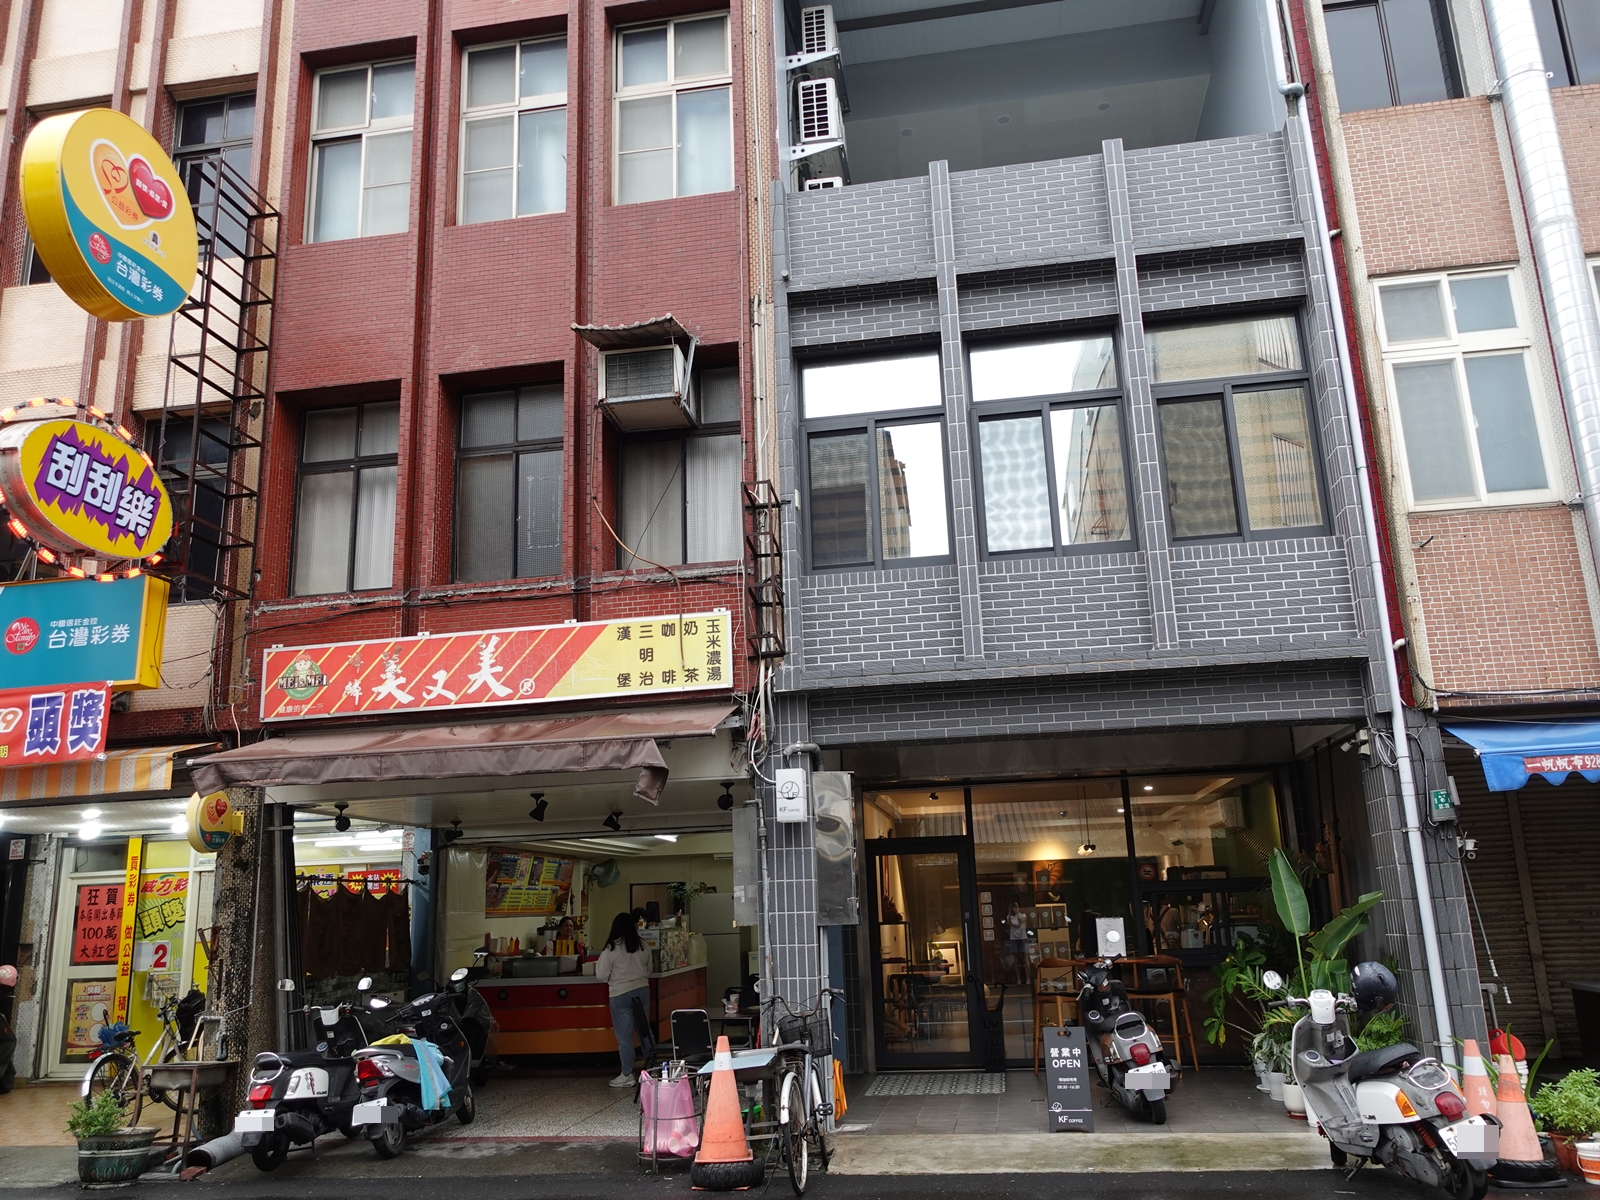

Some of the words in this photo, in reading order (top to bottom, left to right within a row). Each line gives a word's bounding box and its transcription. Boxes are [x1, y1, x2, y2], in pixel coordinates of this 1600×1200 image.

[112, 196, 139, 221] 公益彩券
[116, 260, 163, 302] 台灣彩券
[46, 440, 157, 538] 刮刮樂
[50, 617, 99, 628] 中國信託金控
[48, 623, 131, 649] 台灣彩券
[616, 626, 632, 688] 漢堡
[639, 624, 654, 686] 三明治
[661, 622, 677, 685] 咖啡
[683, 620, 699, 683] 奶茶
[706, 618, 722, 682] 玉米濃湯
[24, 689, 106, 757] 頭獎
[87, 888, 119, 907] 狂賀
[140, 877, 189, 895] 威力彩
[82, 925, 118, 940] 100萬
[79, 944, 119, 959] 大紅包
[1050, 1047, 1082, 1058] 營業中
[1052, 1059, 1081, 1068] OPEN
[1058, 1115, 1069, 1123] KF
